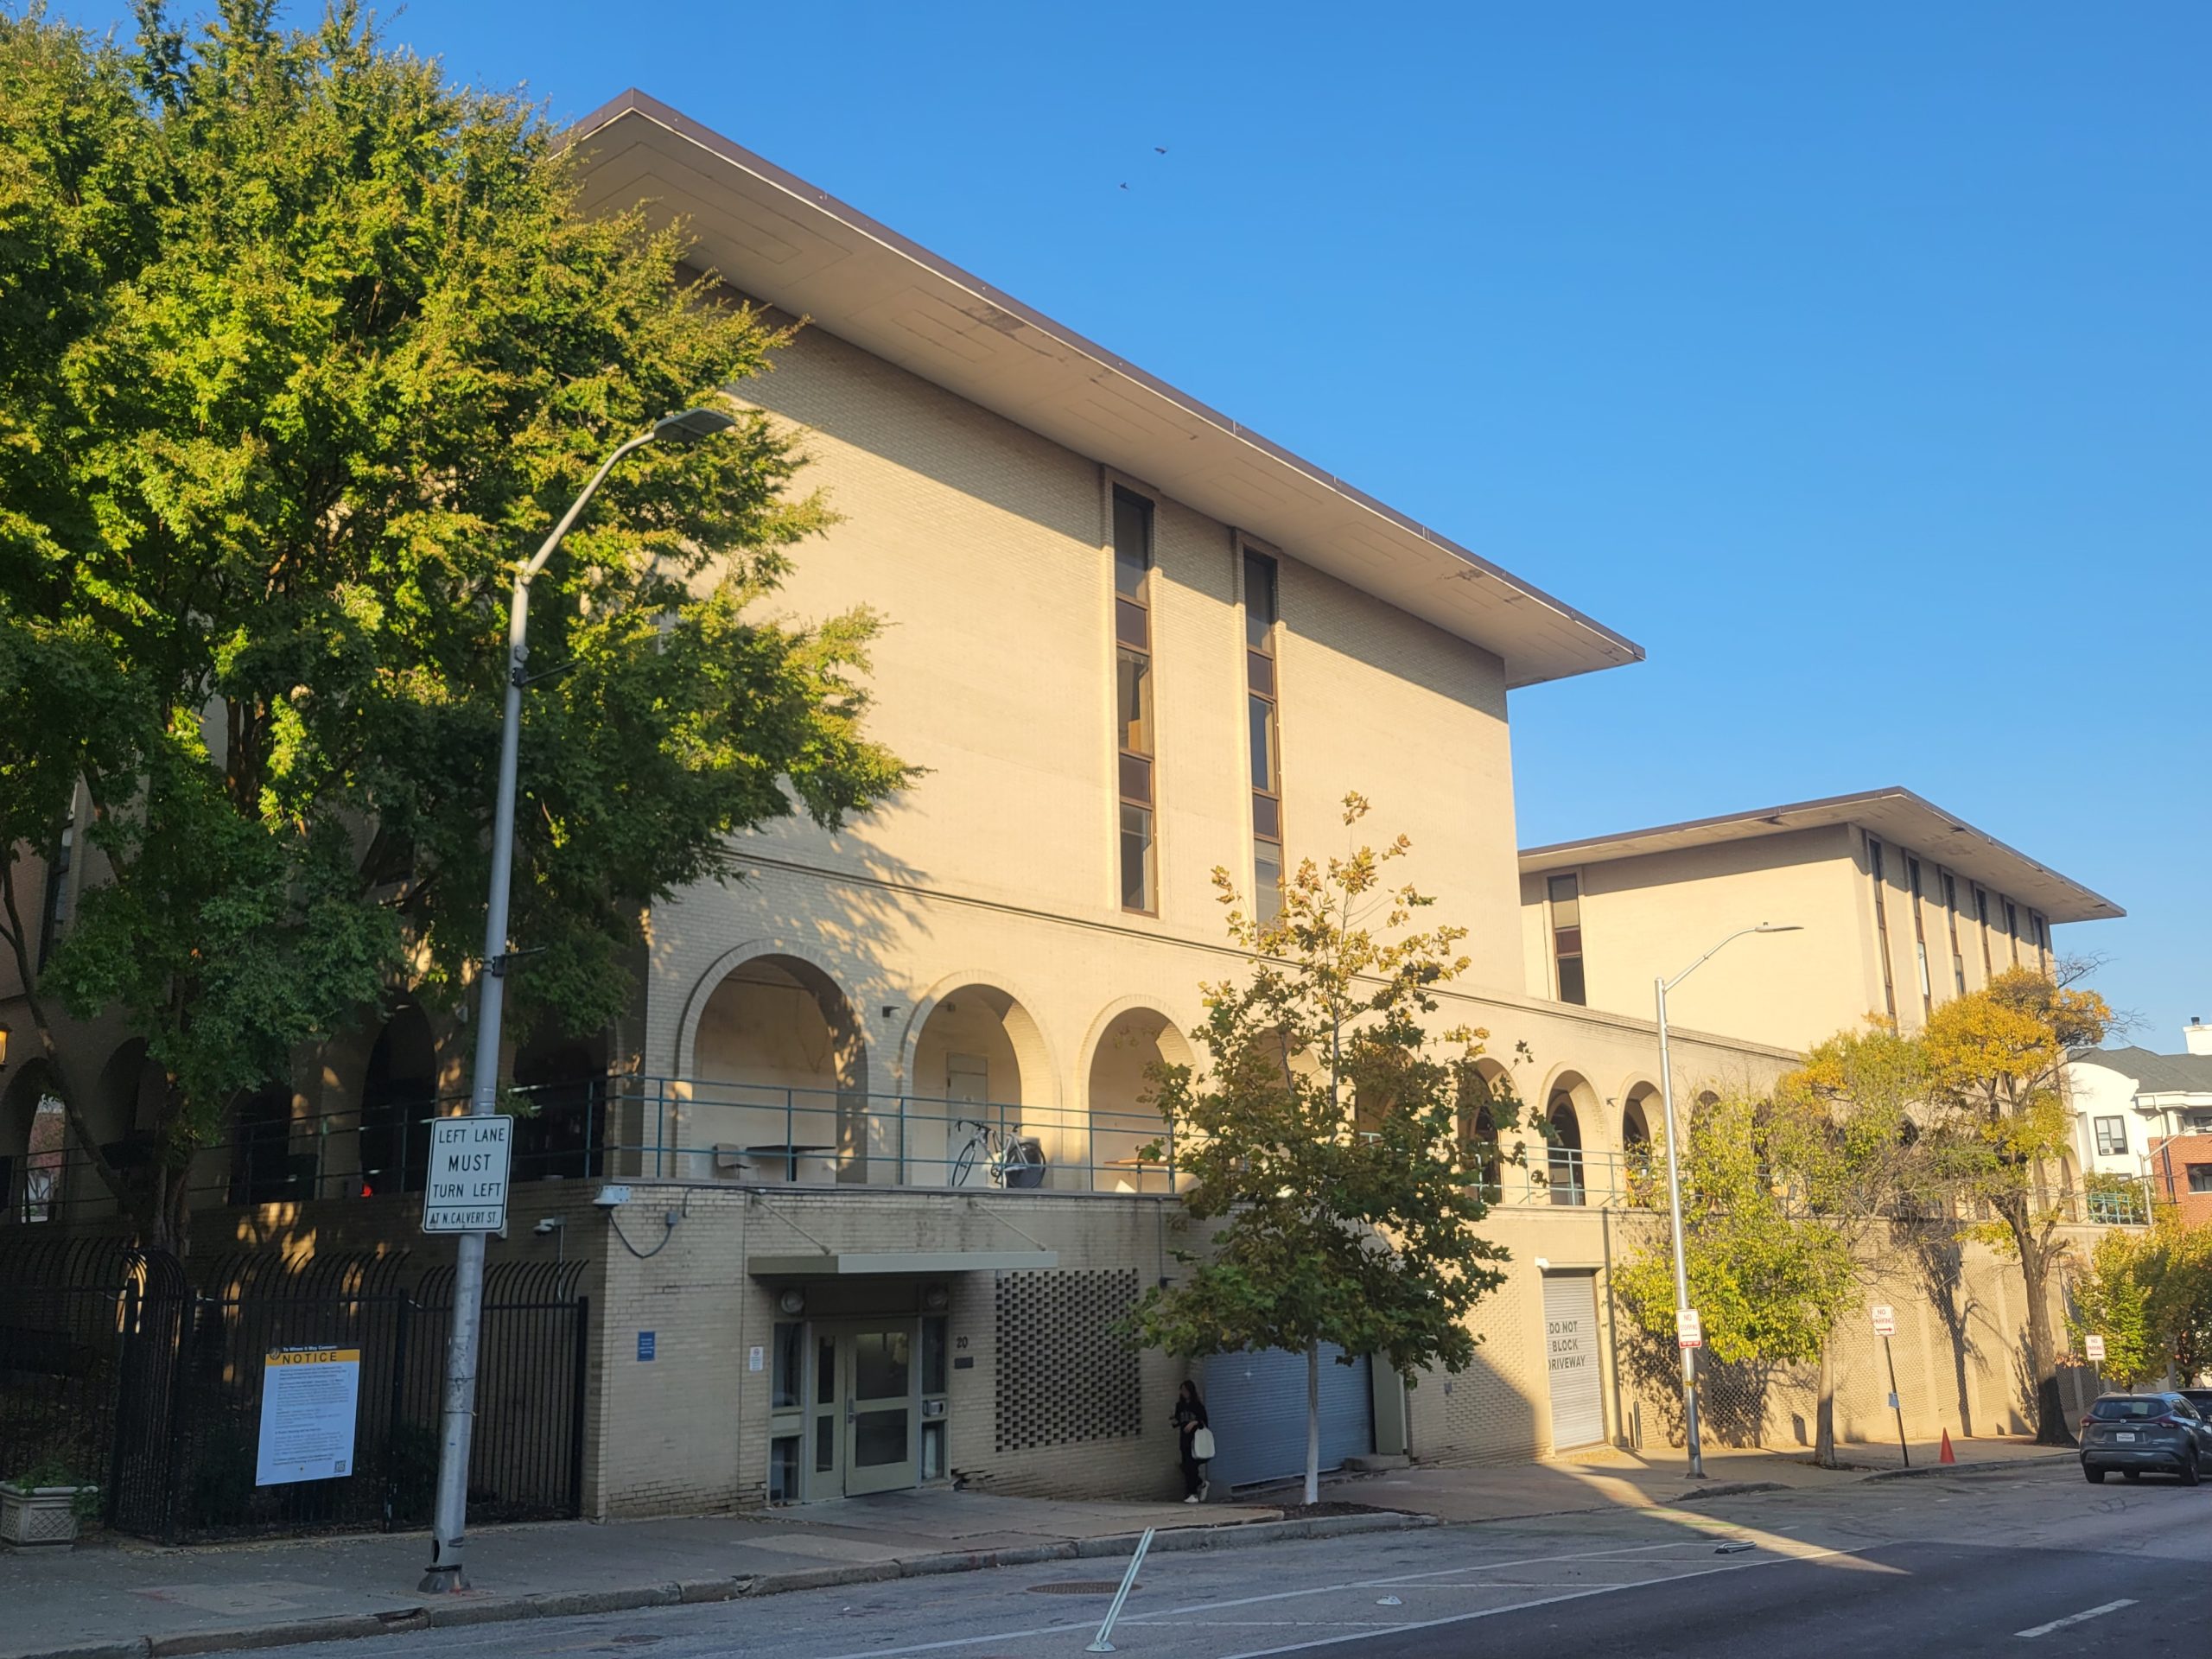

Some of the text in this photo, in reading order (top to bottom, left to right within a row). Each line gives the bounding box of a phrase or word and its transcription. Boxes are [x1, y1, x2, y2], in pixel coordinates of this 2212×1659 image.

[439, 1128, 505, 1144] LEFT LANE
[448, 1154, 491, 1173] MUST
[433, 1182, 502, 1199] TURN LEFT
[429, 1212, 440, 1224] AT
[486, 1211, 499, 1224] ST.
[1548, 1320, 1578, 1334] DO NOT
[957, 1336, 969, 1349] 20
[1552, 1338, 1579, 1352] BLOCK
[282, 1351, 337, 1365] NOTICE
